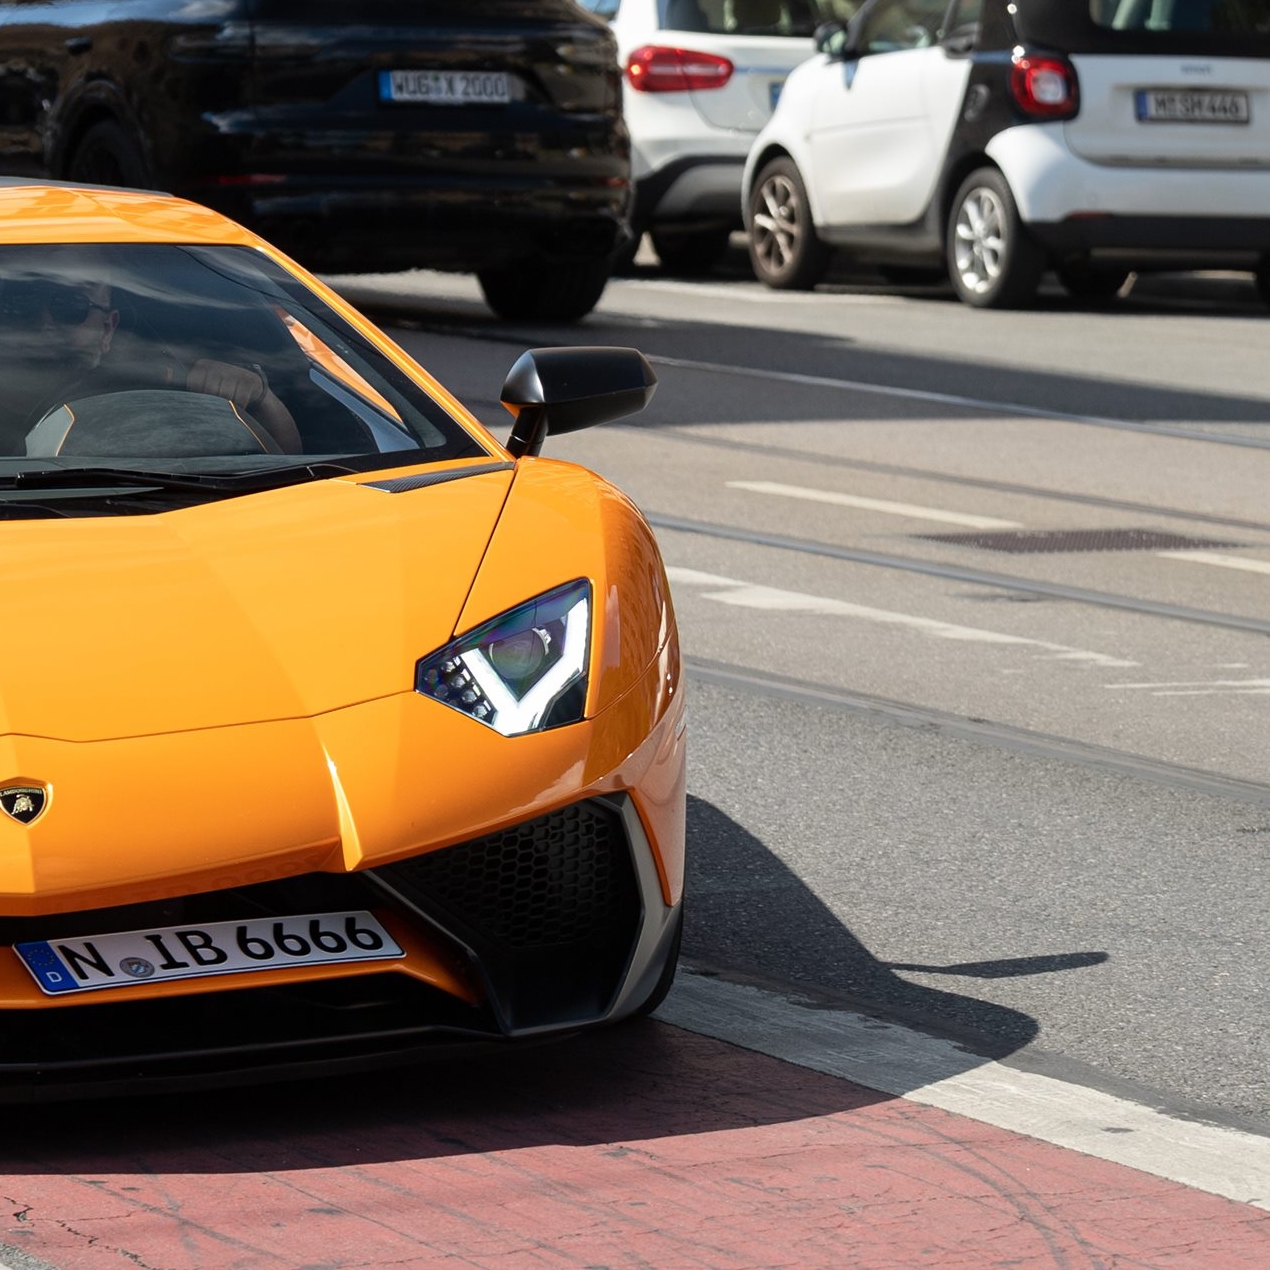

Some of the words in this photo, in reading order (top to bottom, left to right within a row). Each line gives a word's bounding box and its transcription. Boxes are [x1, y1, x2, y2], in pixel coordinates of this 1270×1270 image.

[460, 76, 507, 97] 2000
[0, 788, 43, 797] LAMBORGHINI
[57, 941, 115, 980] N
[145, 929, 228, 970] IB
[236, 916, 383, 961] 6666
[46, 970, 63, 983] D
